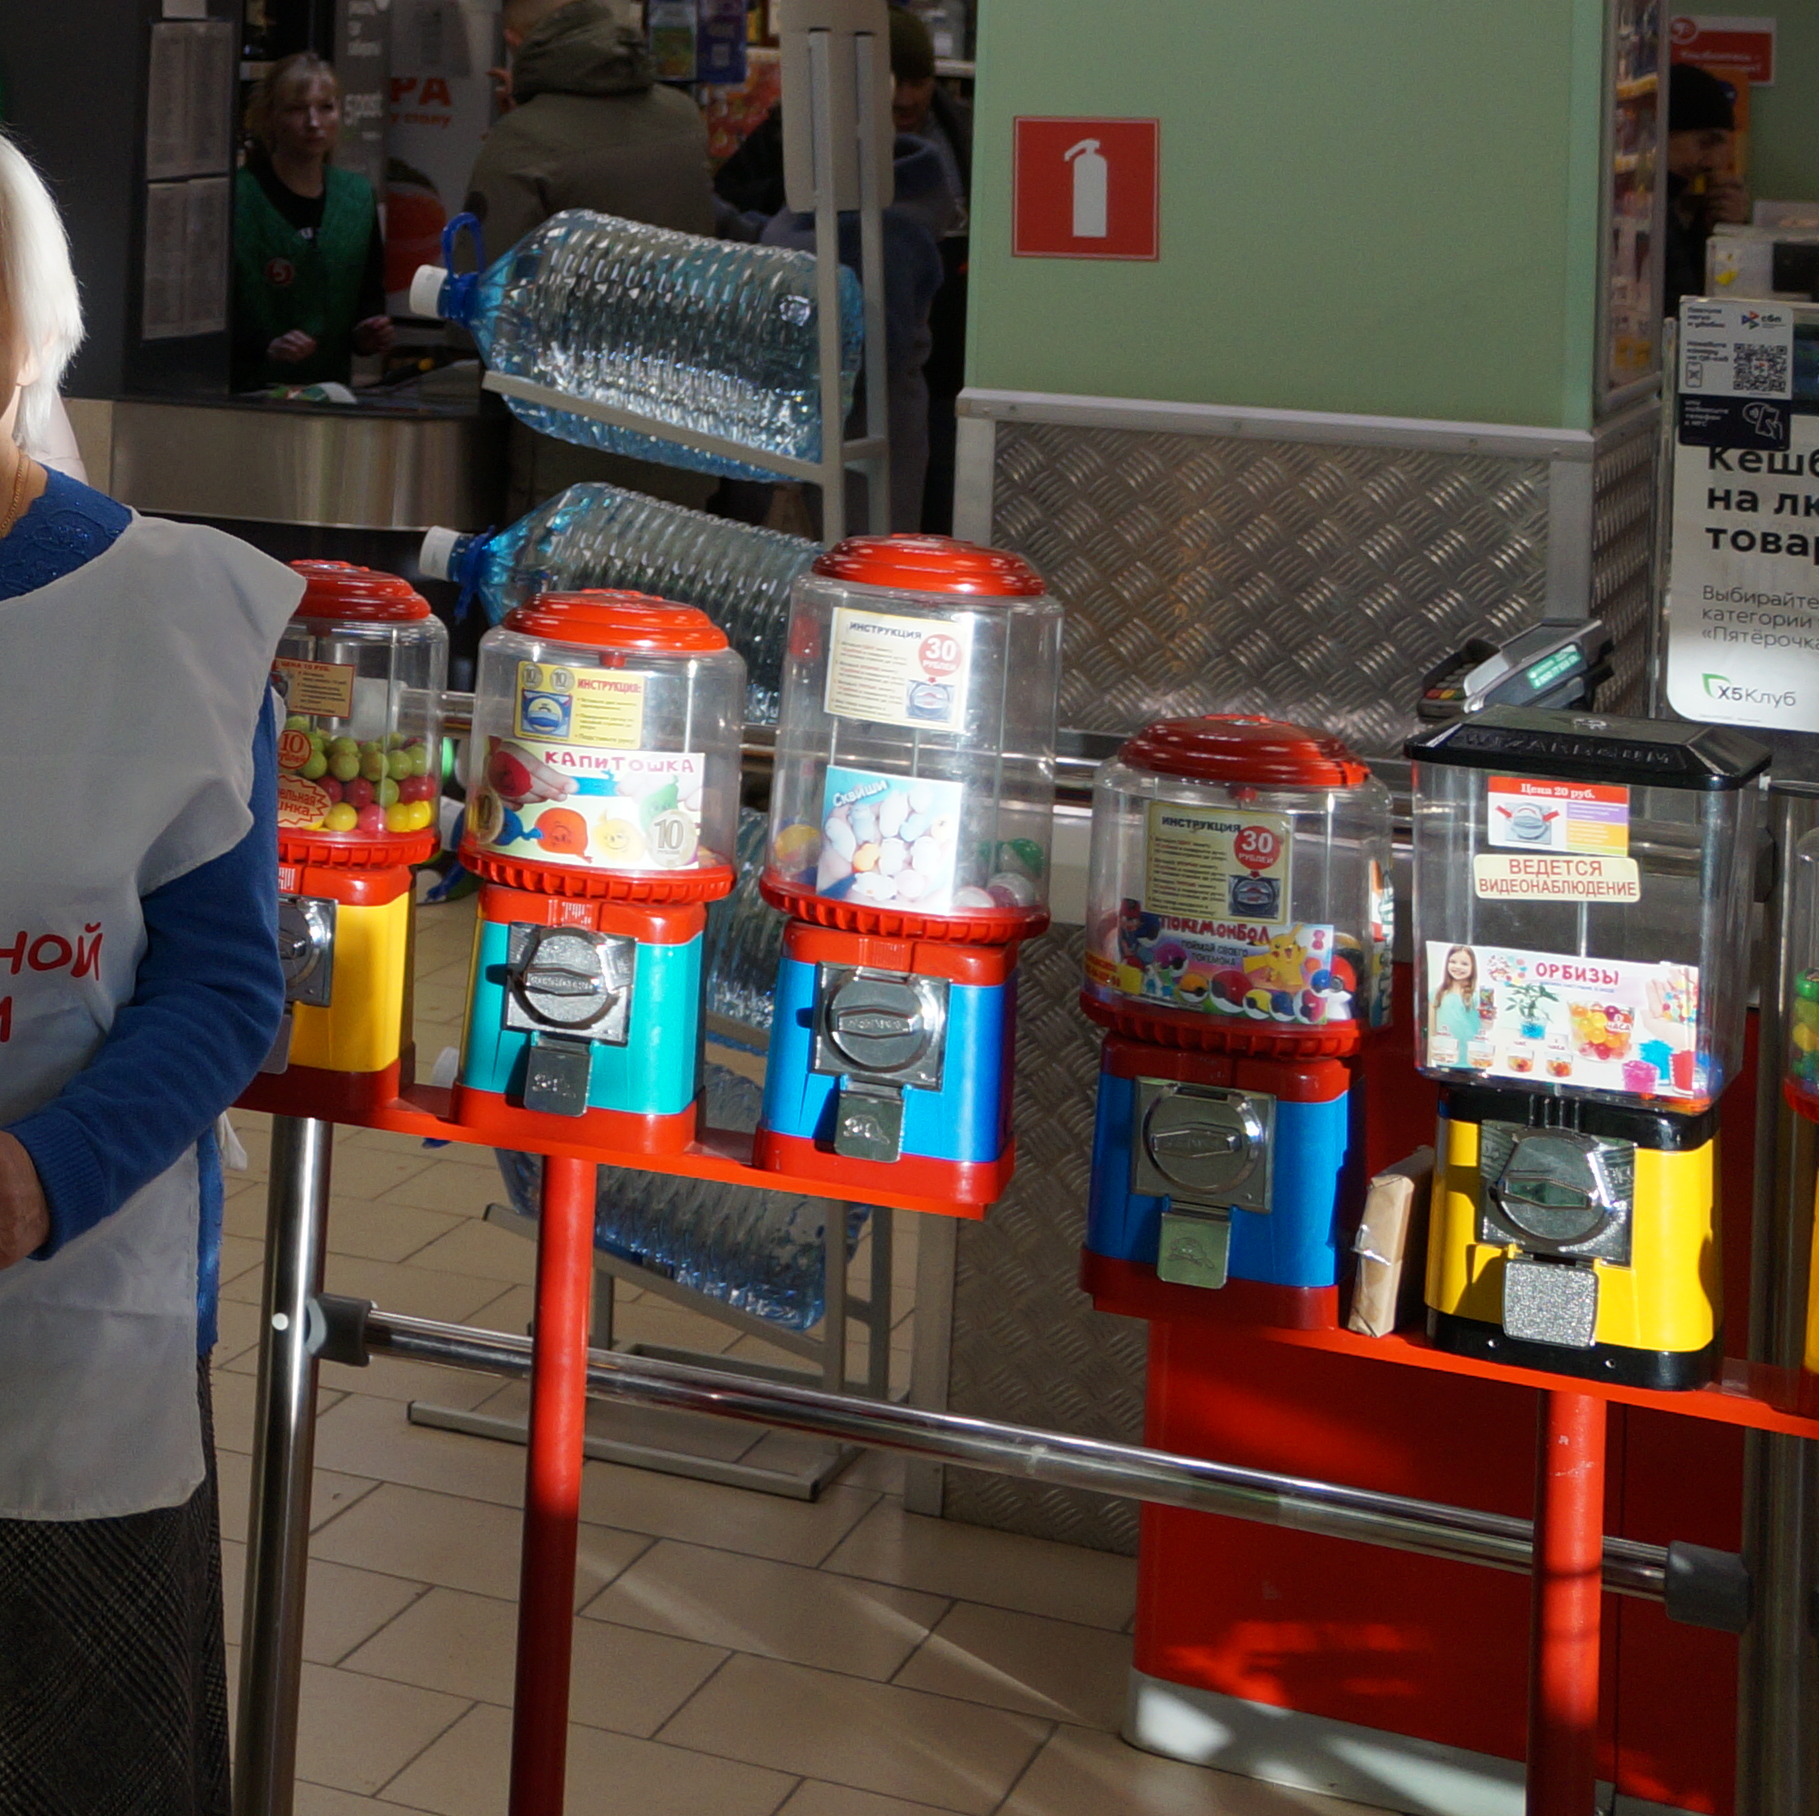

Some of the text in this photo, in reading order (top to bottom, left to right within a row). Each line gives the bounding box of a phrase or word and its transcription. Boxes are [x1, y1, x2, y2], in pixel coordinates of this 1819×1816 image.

[390, 77, 452, 106] РА
[1707, 487, 1759, 512] на
[1705, 527, 1819, 565] това
[1703, 585, 1819, 609] Выбирайте
[1702, 608, 1812, 629] категории
[849, 621, 922, 639] ИНСТРУКЦИЯ
[925, 637, 957, 659] 30
[922, 659, 957, 672] РУБЛЕЙ
[577, 678, 642, 693] ИНСТРУКЦИЯ:
[281, 734, 304, 754] 10
[545, 751, 694, 774] КАПИТОШКА
[279, 788, 316, 806] ельная
[833, 780, 888, 807] Сквиши
[1521, 783, 1596, 800] Цена 20 руб.
[654, 819, 684, 850] 10
[1161, 816, 1241, 833] ИНСТРУКЦИЯ
[1242, 831, 1273, 853] 30
[1238, 853, 1274, 865] РУБЛЕЙ
[1508, 858, 1603, 877] ВЕДЕТСЯ
[1478, 878, 1637, 897] ВИДЕОНАБЛЮДЕНИЕ
[1161, 915, 1271, 943] ПОКЕМОНБОЛ
[1181, 939, 1215, 953] ПОЙМАЙ
[1535, 962, 1620, 986] ОРБИЗЫ
